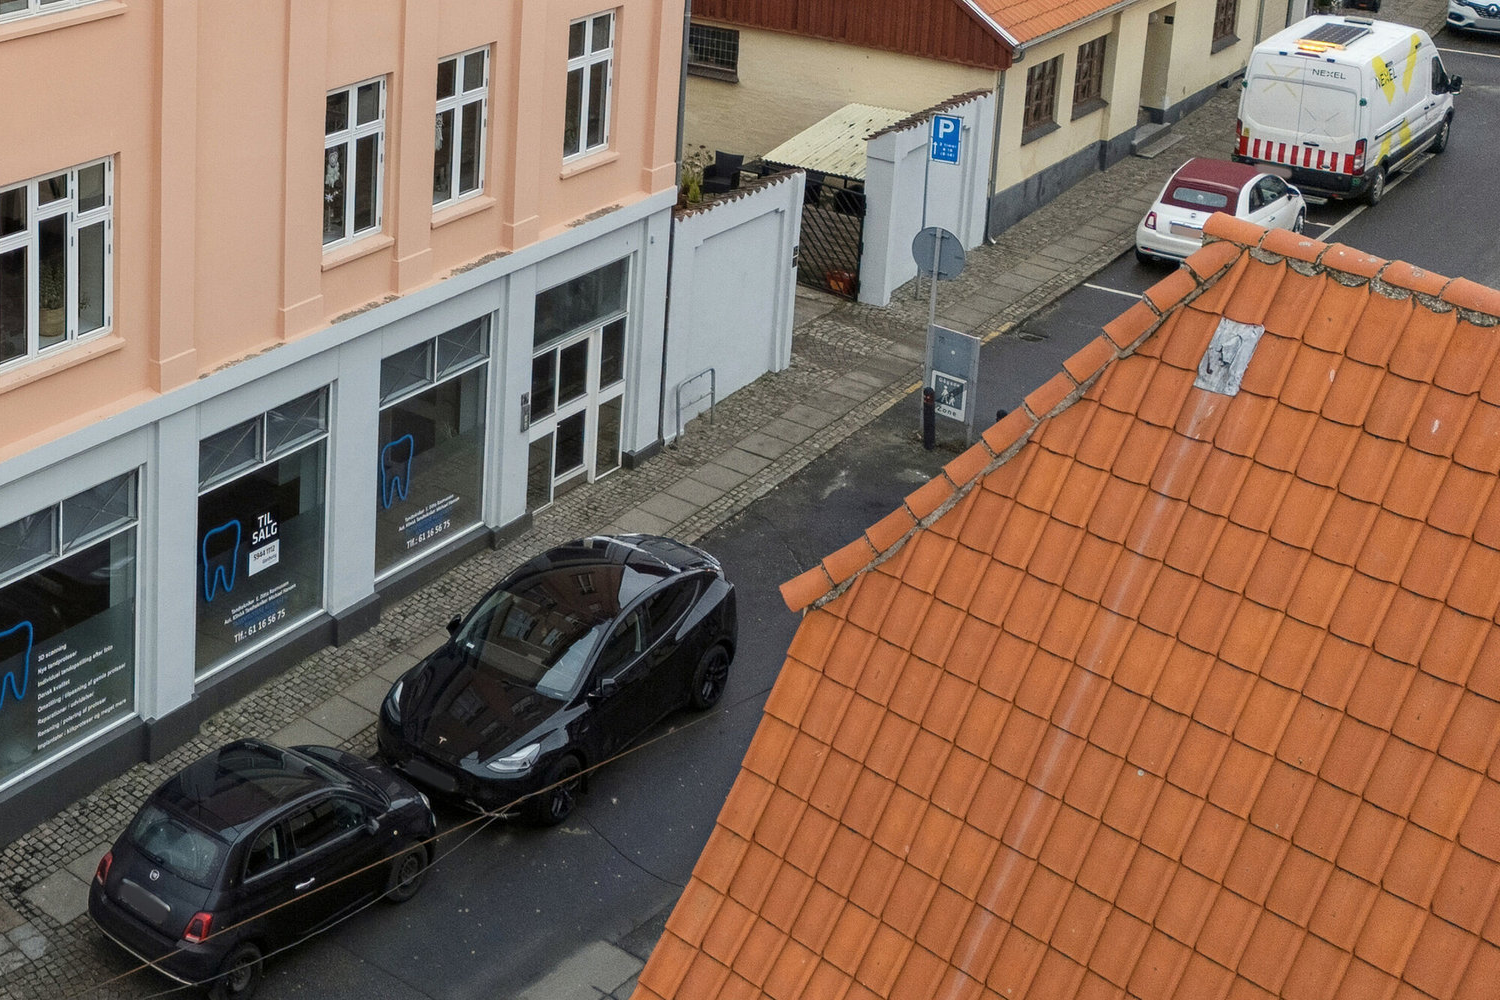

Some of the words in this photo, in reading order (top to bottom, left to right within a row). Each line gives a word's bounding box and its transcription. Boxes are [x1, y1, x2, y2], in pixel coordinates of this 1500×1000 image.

[1312, 68, 1346, 80] NEXEL
[1375, 67, 1397, 90] NEXEL
[939, 119, 955, 138] P
[937, 406, 957, 416] Zone
[258, 512, 273, 528] TIL
[252, 522, 277, 545] SALG
[407, 538, 418, 549] Tlf.:
[419, 533, 426, 542] 61
[427, 528, 434, 539] 16
[435, 524, 442, 534] 56
[443, 519, 450, 529] 75
[234, 630, 247, 643] Tlf.:
[248, 624, 256, 635] 61
[258, 619, 266, 630] 16
[268, 613, 276, 625] 56
[277, 608, 286, 620] 75
